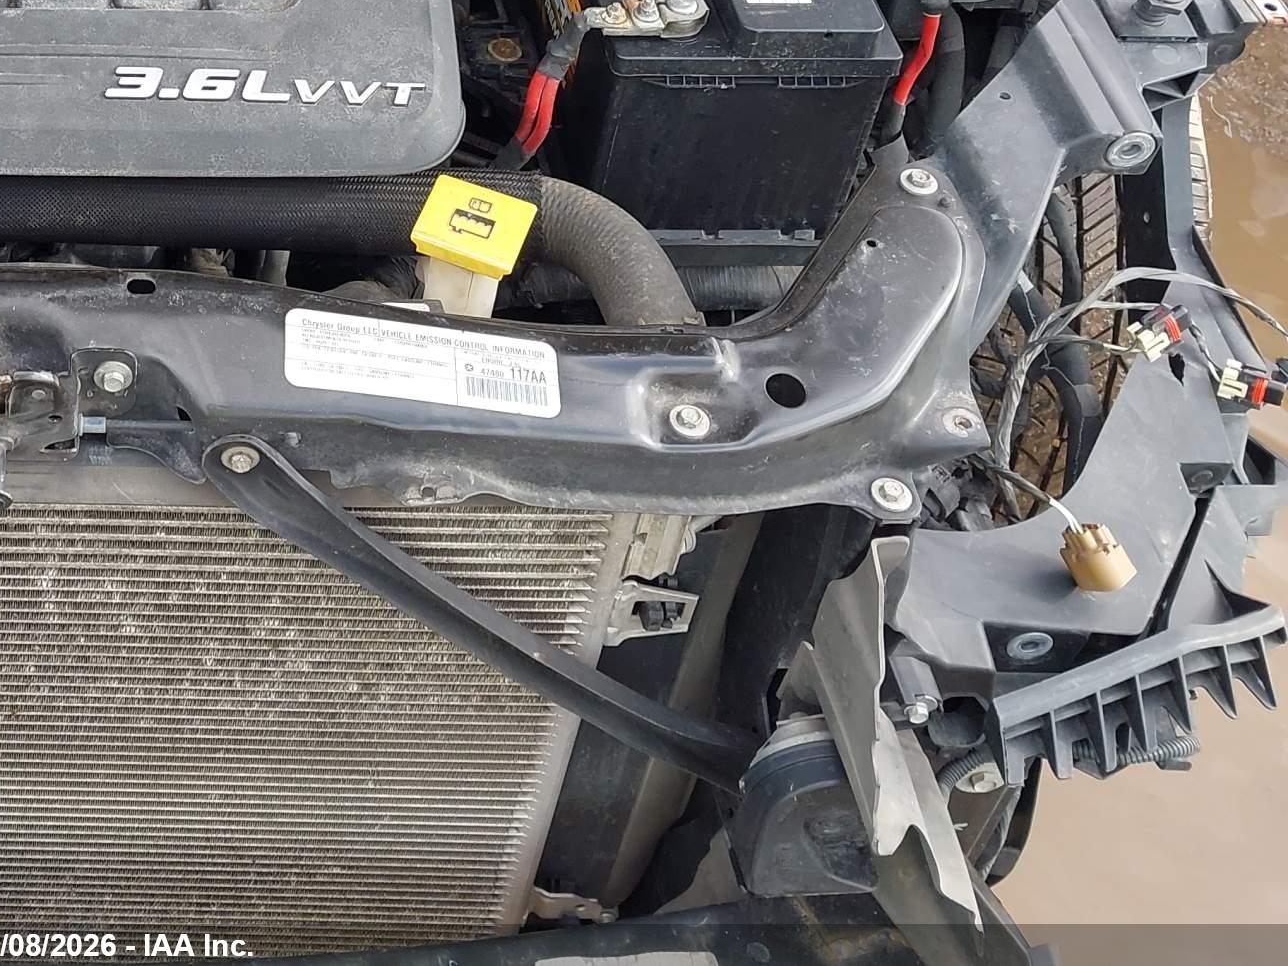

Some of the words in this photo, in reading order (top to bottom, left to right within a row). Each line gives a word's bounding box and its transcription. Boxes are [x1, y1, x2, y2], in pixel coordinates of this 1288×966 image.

[104, 66, 290, 103] 3.6L
[294, 79, 426, 108] VVT
[302, 318, 334, 329] Chrysler
[337, 323, 360, 334] Group
[364, 326, 378, 335] LLC
[380, 329, 412, 340] VEHICLE
[416, 334, 452, 346] EMISSION
[454, 339, 488, 350] CONTROL
[492, 345, 545, 358] INFORMATION
[510, 367, 546, 384] 117AA
